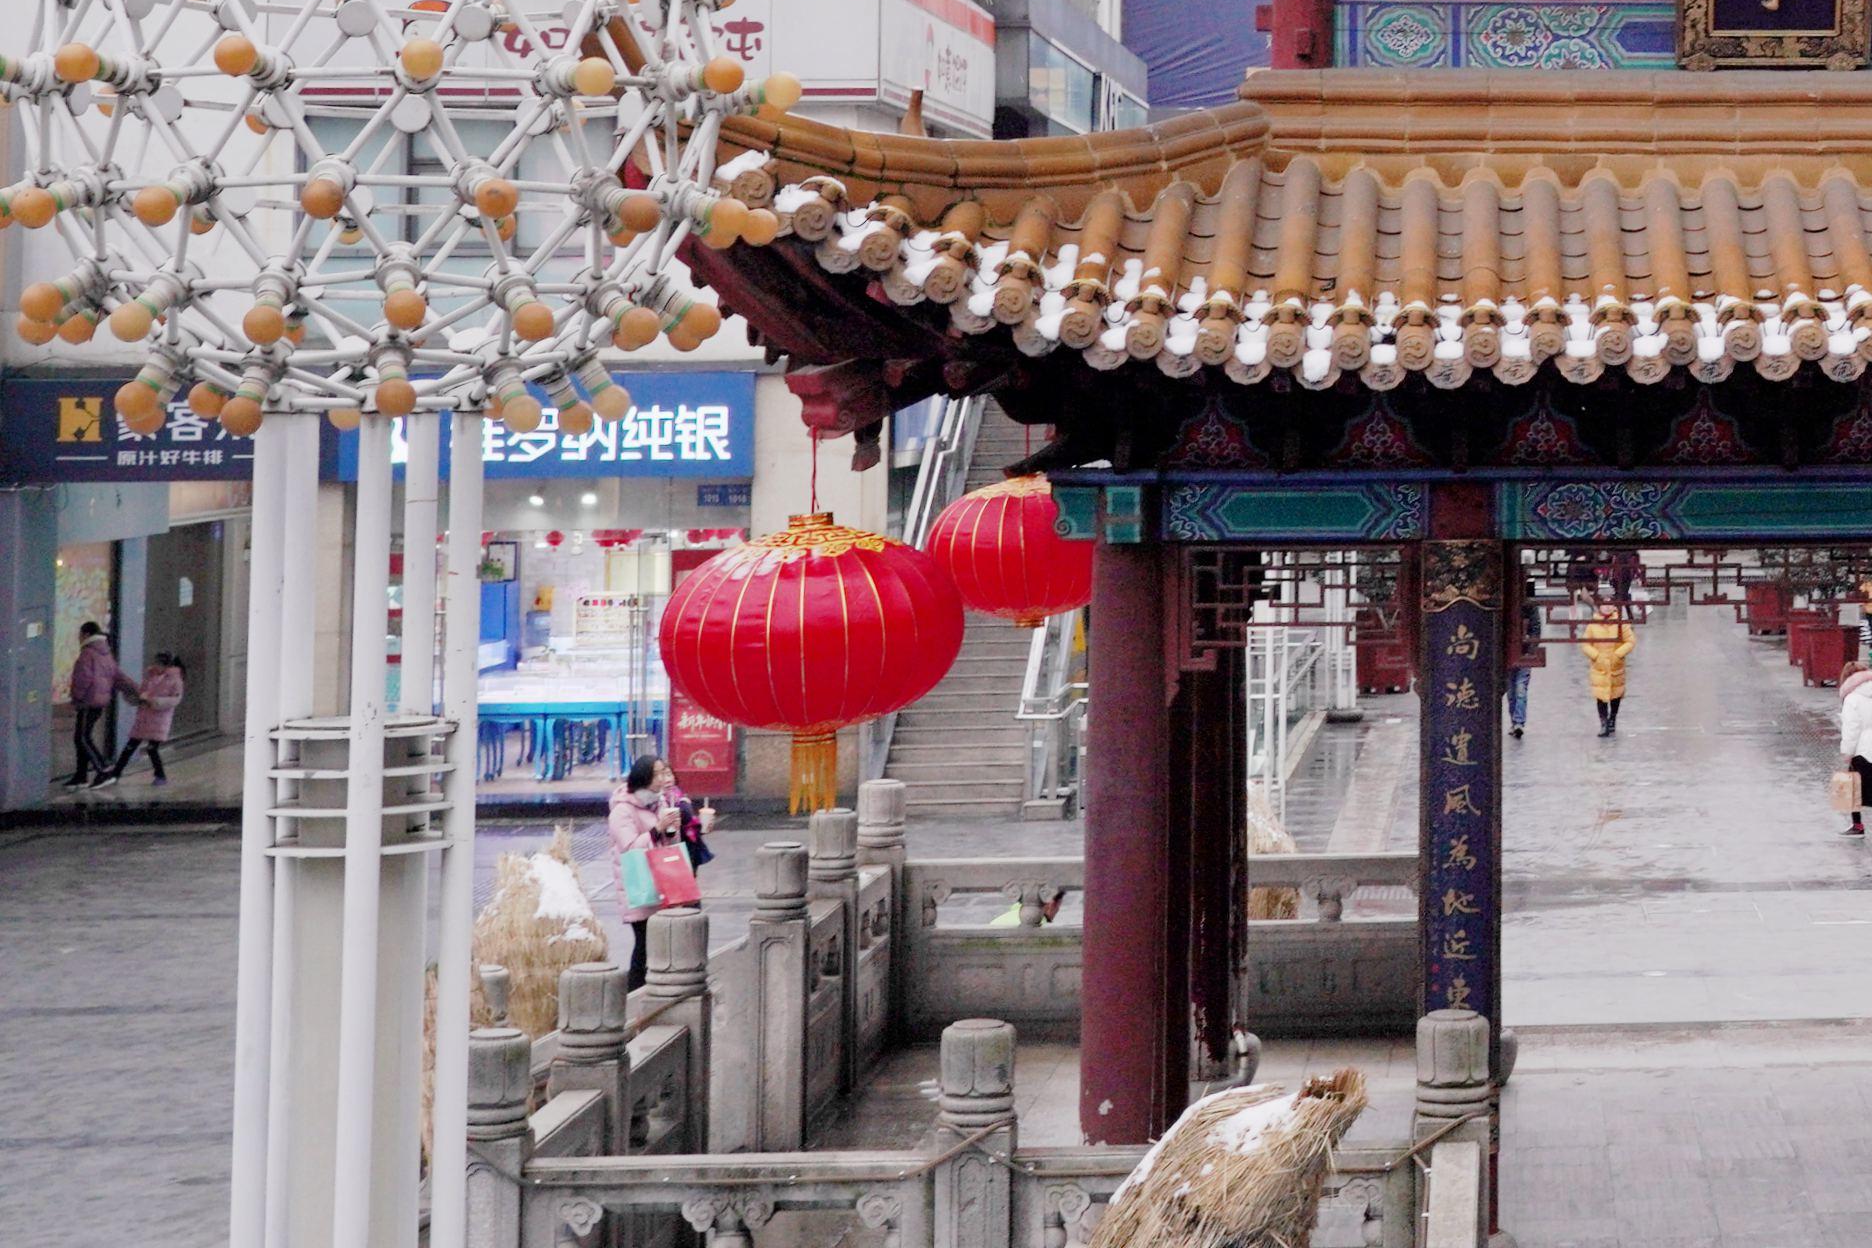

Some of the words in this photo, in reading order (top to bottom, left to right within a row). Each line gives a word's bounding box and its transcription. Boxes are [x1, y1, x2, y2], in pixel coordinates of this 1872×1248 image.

[117, 449, 224, 467] 原汁好牛排
